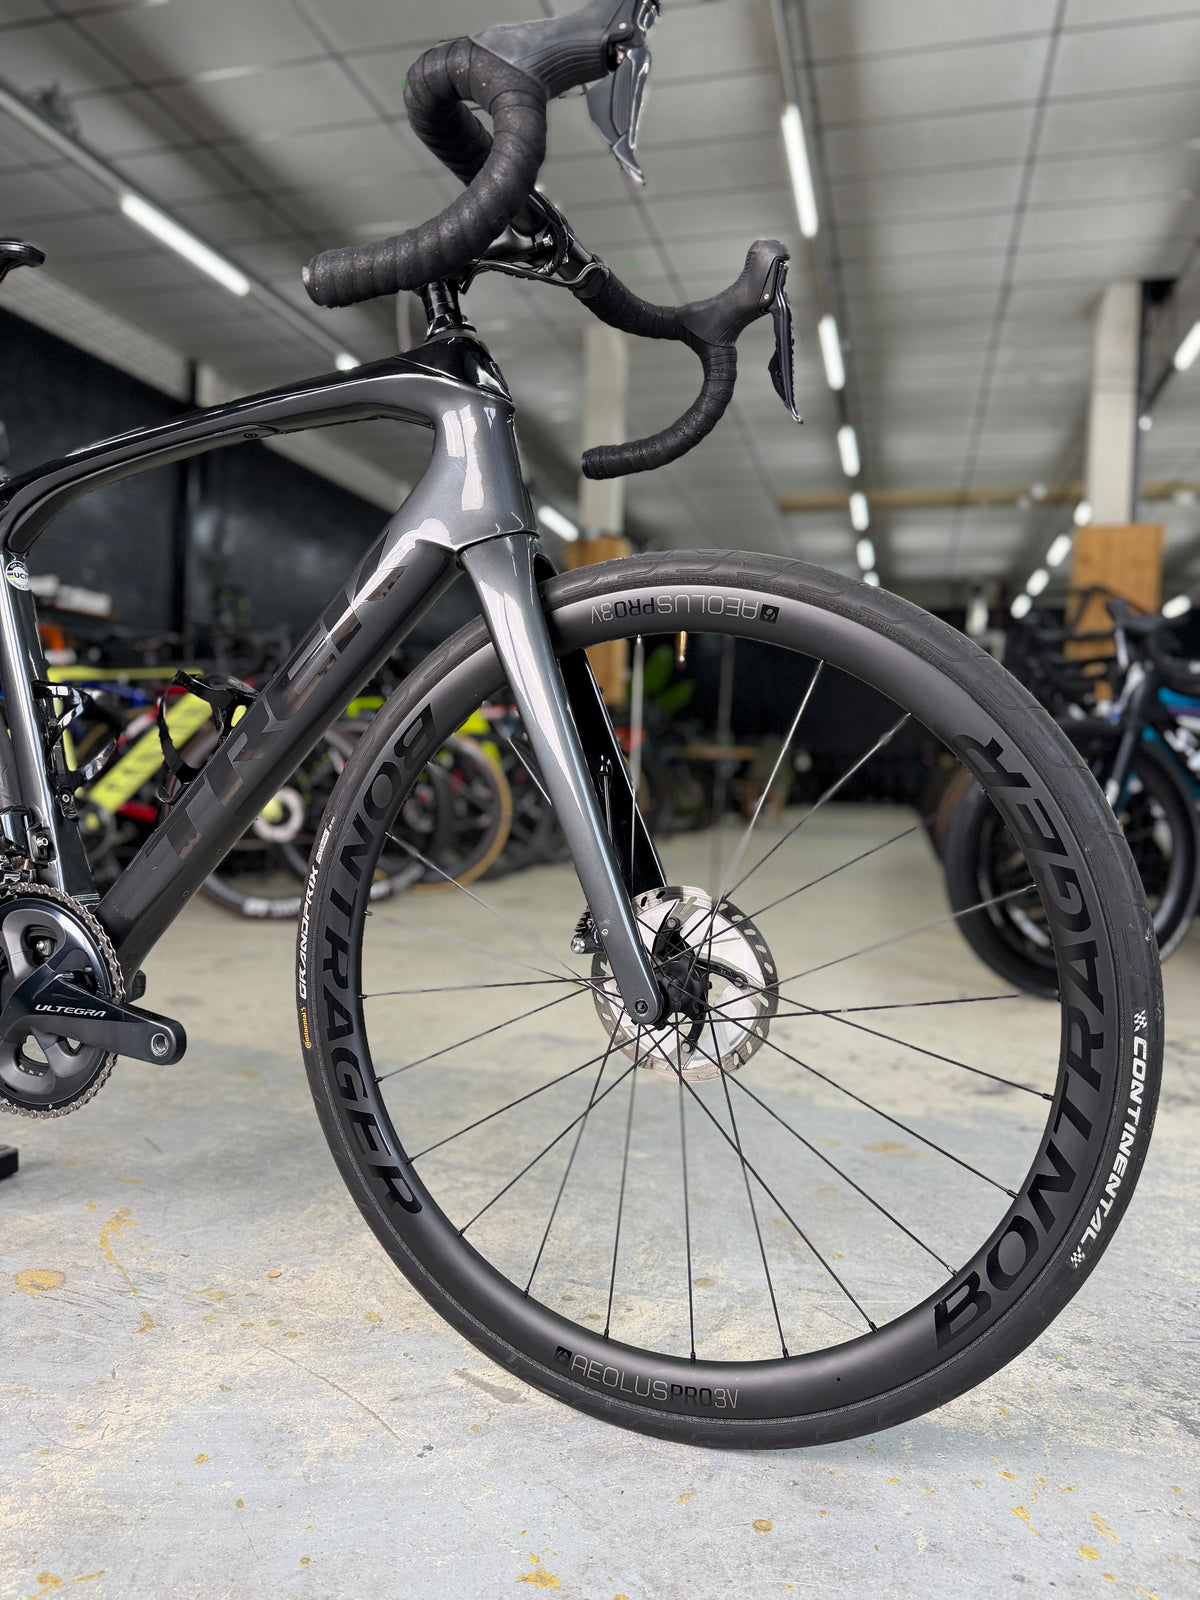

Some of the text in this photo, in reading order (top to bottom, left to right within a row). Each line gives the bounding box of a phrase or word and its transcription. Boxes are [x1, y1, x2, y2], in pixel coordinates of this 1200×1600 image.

[145, 530, 408, 861] TREK
[36, 1004, 106, 1017] ULTEGRA
[302, 1012, 311, 1049] Continental
[323, 703, 437, 1214] BONTRAGER
[935, 734, 1104, 1350] BONTRAGER
[1080, 1035, 1148, 1245] CONTINENTAL
